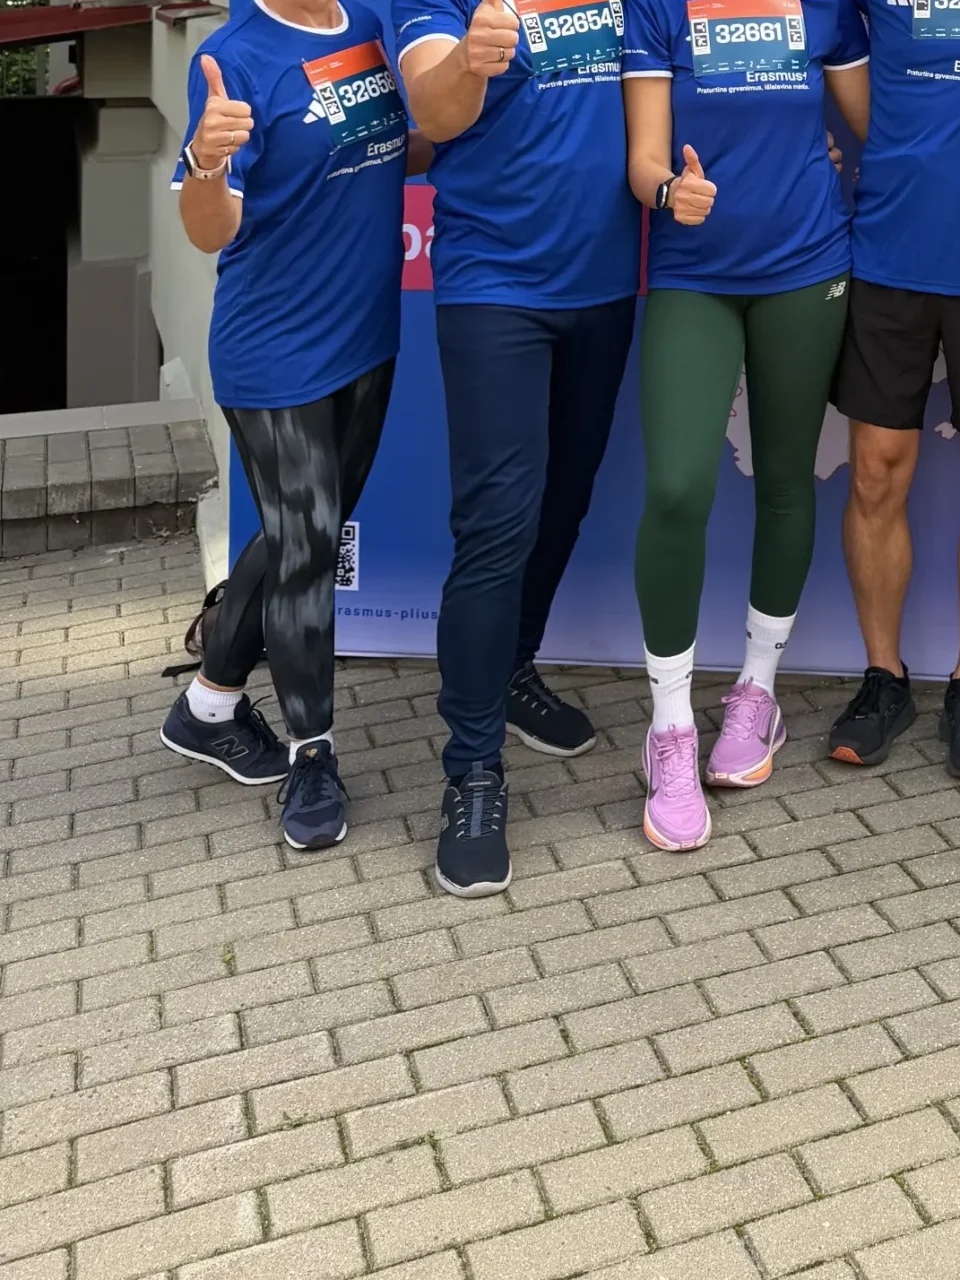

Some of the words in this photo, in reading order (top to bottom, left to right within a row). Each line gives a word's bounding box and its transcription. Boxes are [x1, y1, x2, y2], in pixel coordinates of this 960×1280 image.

[544, 7, 613, 39] 32654
[715, 22, 783, 44] 32661
[339, 70, 396, 108] 32658
[337, 606, 438, 621] rasmus-plius
